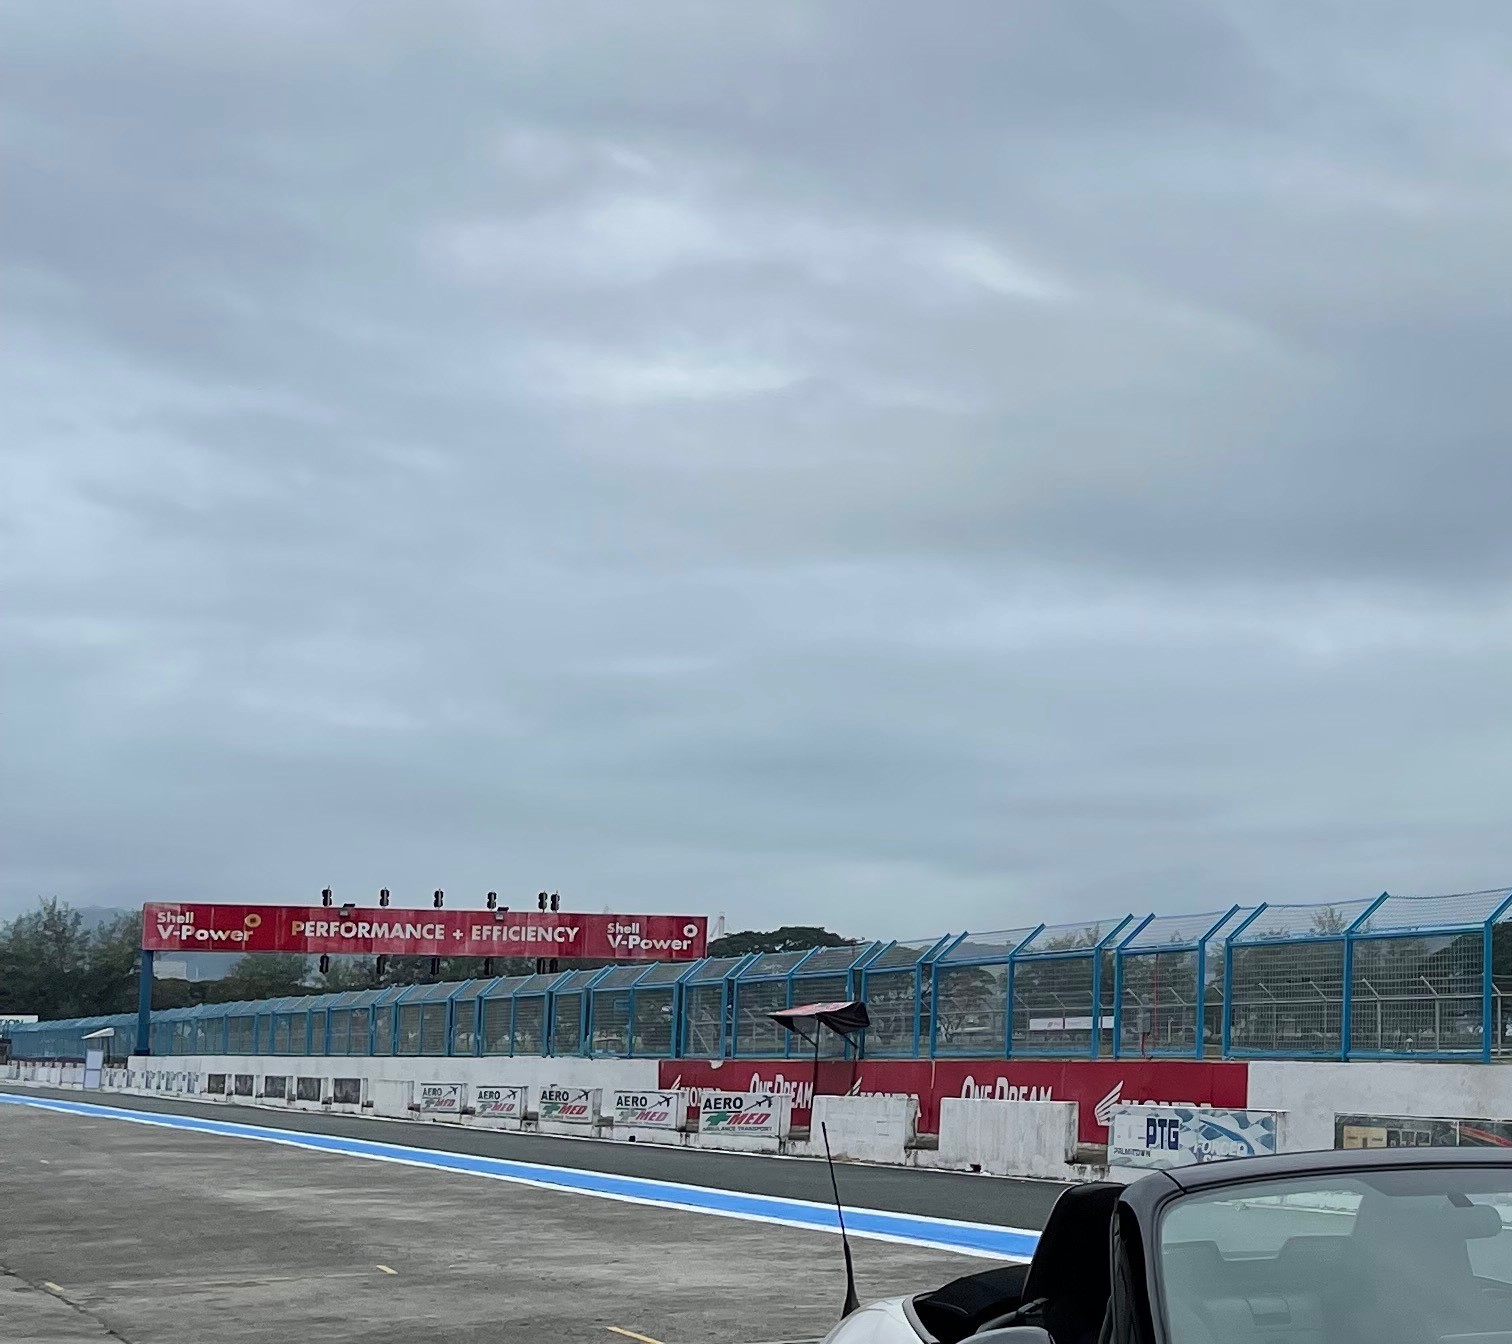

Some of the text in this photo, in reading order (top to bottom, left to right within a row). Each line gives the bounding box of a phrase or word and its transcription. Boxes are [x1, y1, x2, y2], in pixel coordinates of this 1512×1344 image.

[157, 911, 194, 924] Shell
[157, 924, 254, 941] V-Power
[292, 920, 445, 940] PERFORMANCE
[471, 925, 580, 943] EFFICIENCY
[607, 922, 640, 934] Shell
[607, 934, 692, 950] V-Power
[477, 1090, 501, 1100] AERO
[540, 1090, 570, 1102] AERO
[616, 1095, 648, 1107] AERO
[702, 1096, 744, 1110] AERO
[558, 1104, 588, 1115] MED
[635, 1111, 669, 1122] MED
[726, 1113, 772, 1125] MED
[1146, 1117, 1180, 1151] PTG
